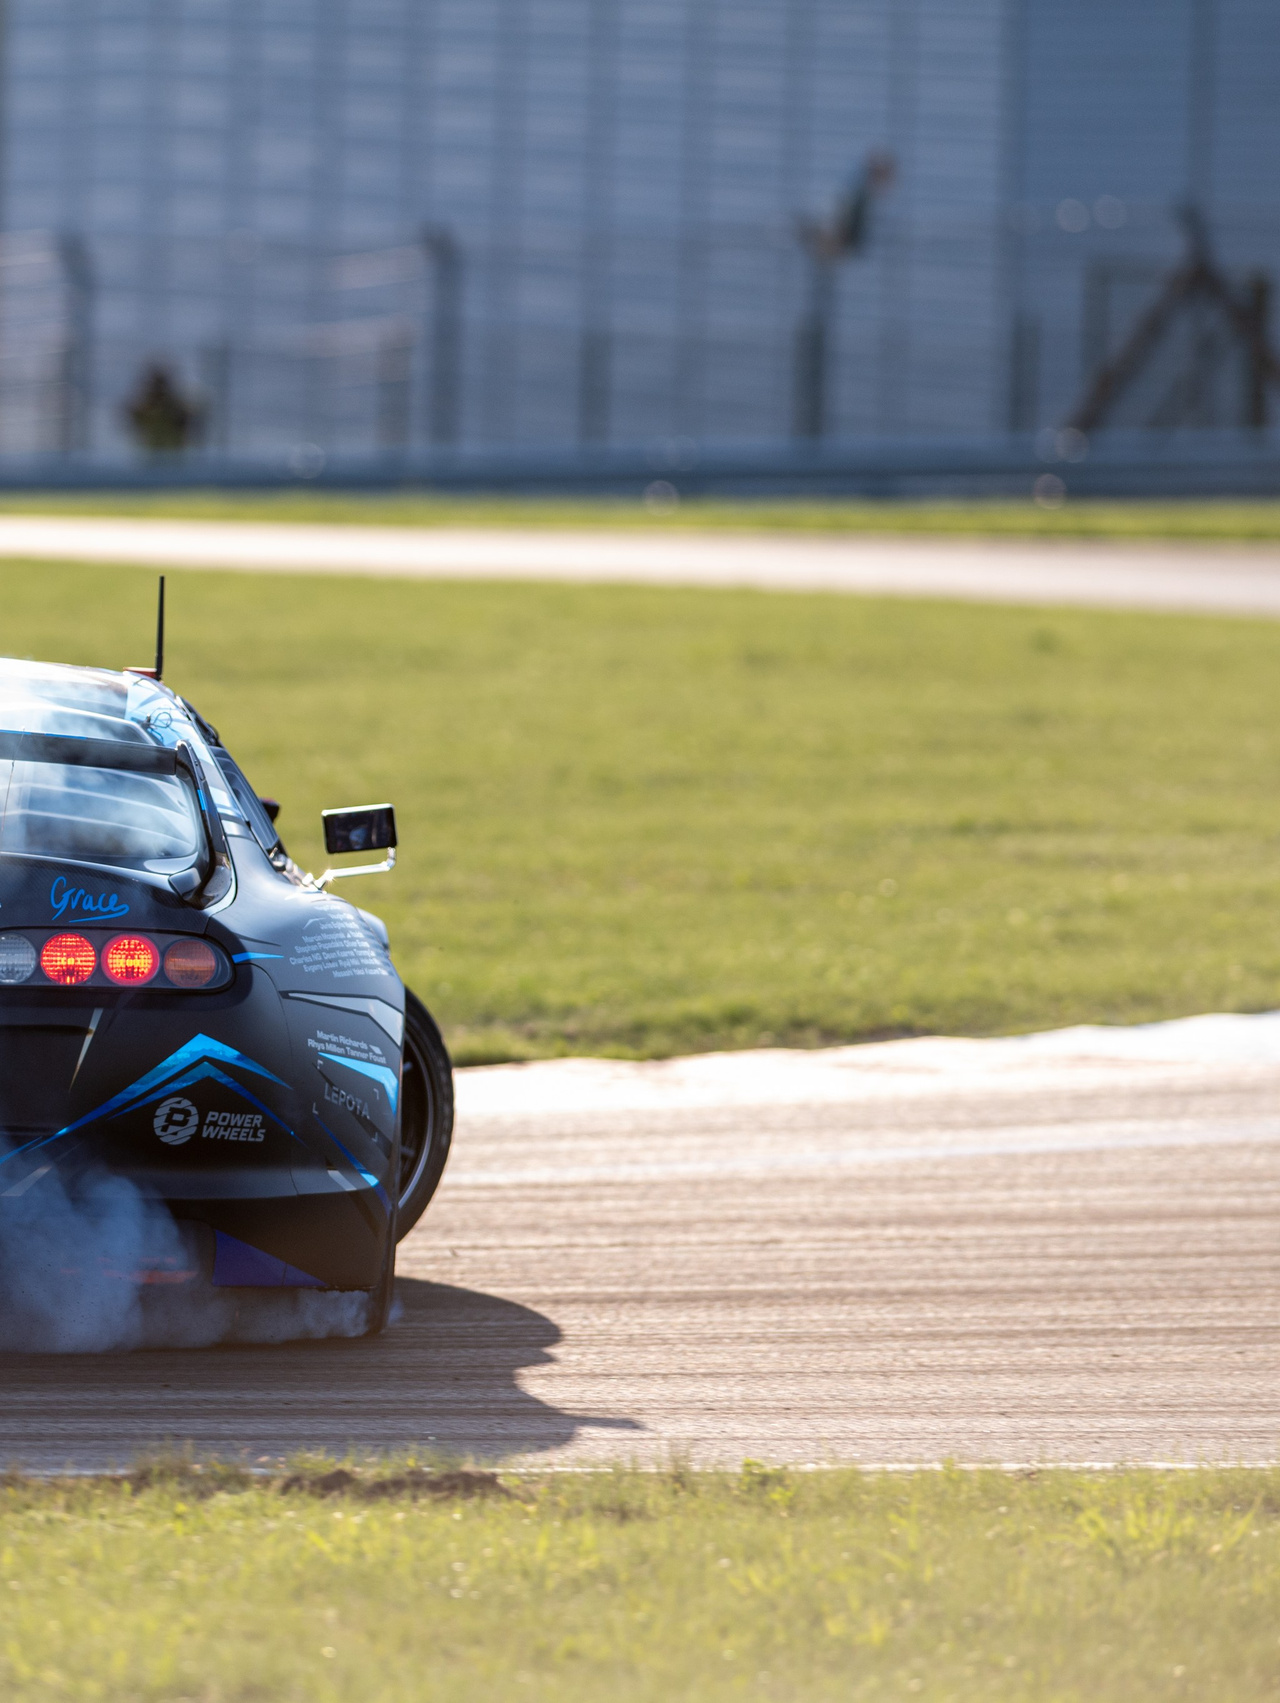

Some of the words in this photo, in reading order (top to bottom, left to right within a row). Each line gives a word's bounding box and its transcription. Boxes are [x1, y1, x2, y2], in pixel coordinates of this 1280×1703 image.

[50, 875, 130, 923] Grace
[317, 1030, 338, 1042] Martin
[339, 1035, 368, 1049] Richards
[307, 1038, 325, 1051] Rhys
[346, 1047, 368, 1059] Tanner
[369, 1053, 387, 1064] Foust
[324, 1082, 370, 1119] LEPOTA
[206, 1111, 263, 1128] POWER
[201, 1125, 266, 1142] WHEELS
